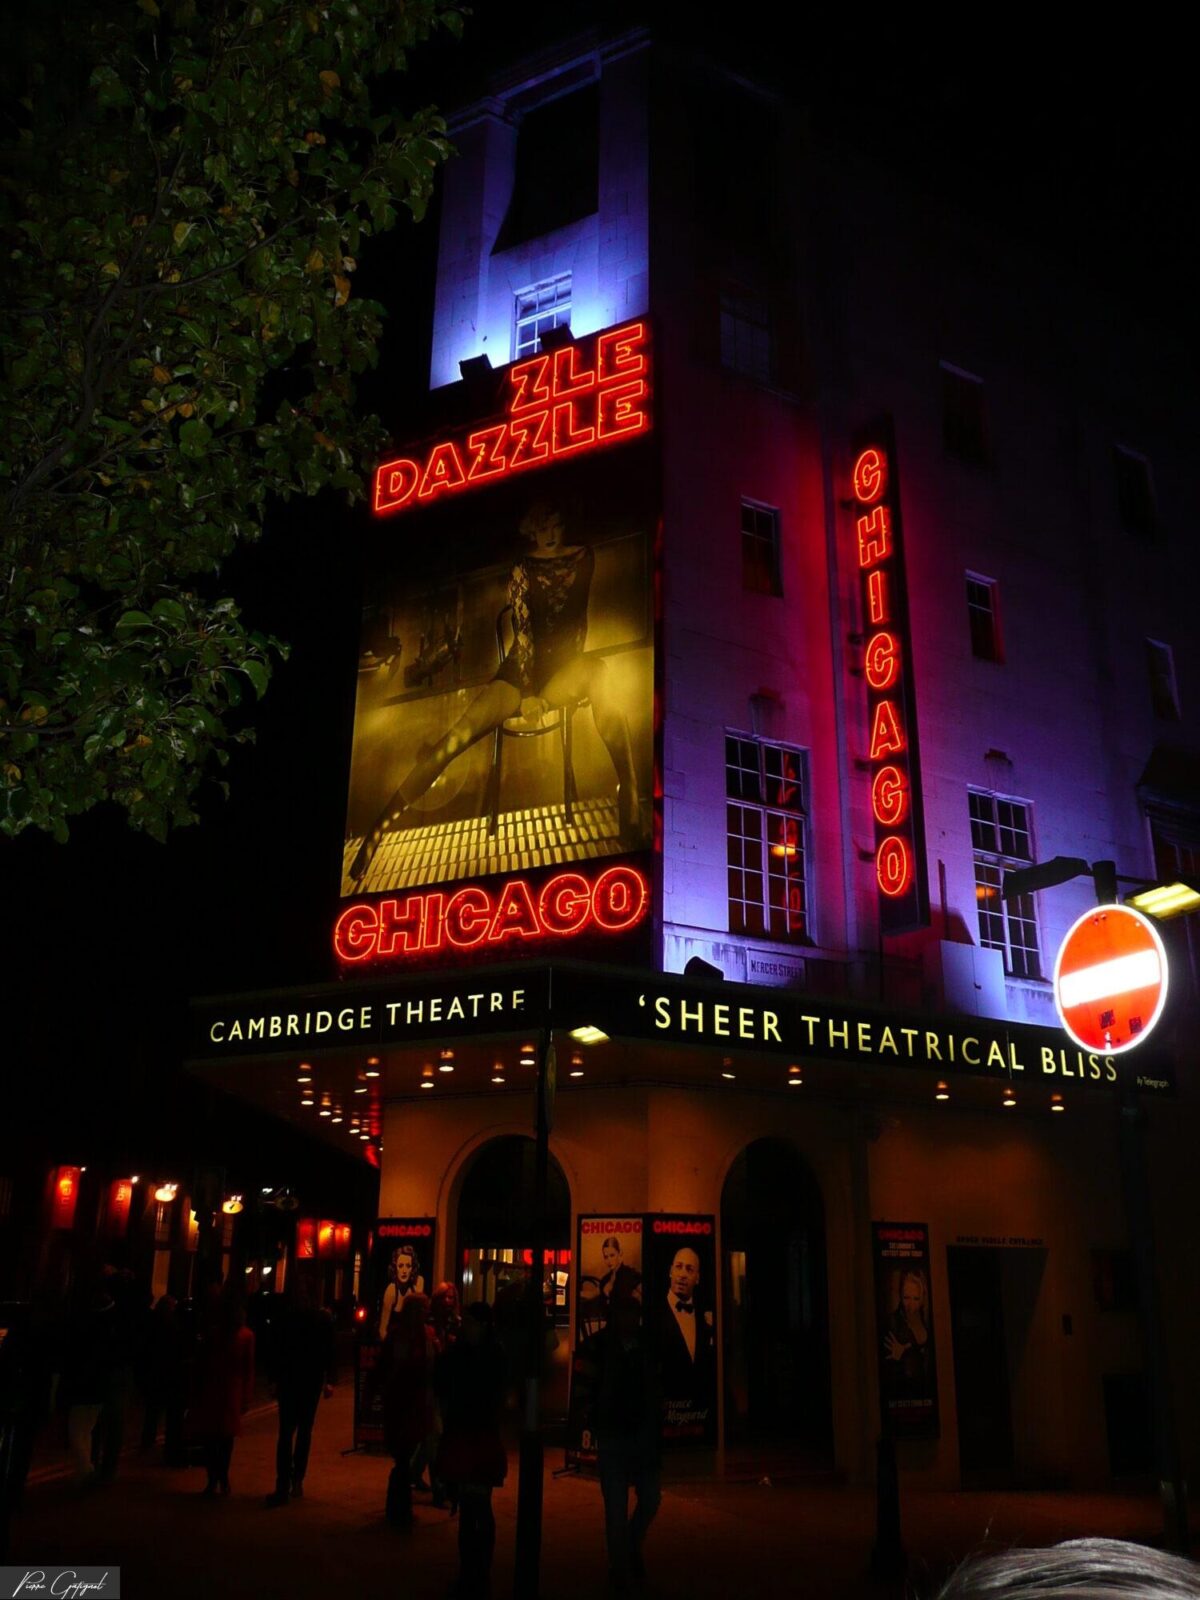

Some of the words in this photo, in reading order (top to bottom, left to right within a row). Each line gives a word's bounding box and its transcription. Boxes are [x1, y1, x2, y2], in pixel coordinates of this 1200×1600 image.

[509, 321, 645, 413] ZLE
[373, 378, 645, 512] DAZZLE
[853, 448, 908, 896] CHICAGO
[333, 866, 648, 962] CHICAGO
[210, 1006, 373, 1043] CAMBRIDGE
[801, 1015, 1025, 1071] THEATRICAL
[1041, 1046, 1118, 1082] BLISS
[379, 1224, 432, 1237] CHICAGO
[582, 1220, 642, 1235] CHICAGO
[653, 1218, 712, 1236] CHICAGO
